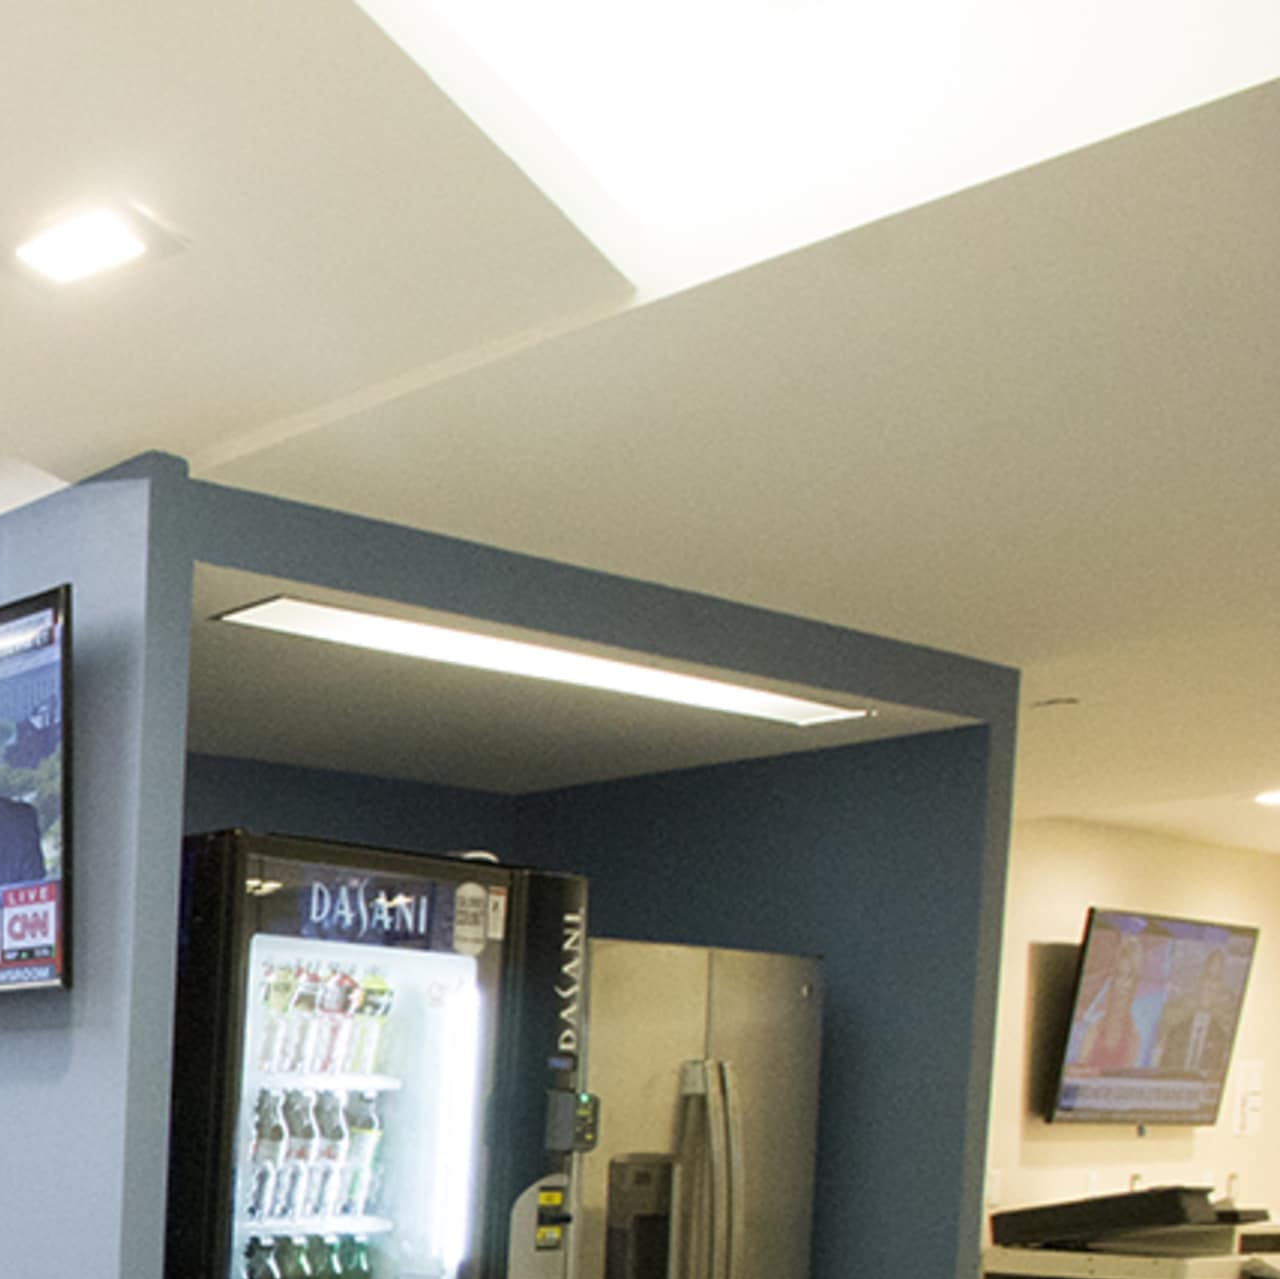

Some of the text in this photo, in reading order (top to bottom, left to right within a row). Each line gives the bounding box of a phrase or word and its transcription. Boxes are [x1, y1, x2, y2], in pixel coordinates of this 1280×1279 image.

[7, 888, 49, 906] LIVE
[309, 878, 428, 939] DASANI
[8, 911, 49, 941] CNN
[554, 913, 583, 1050] DASANI
